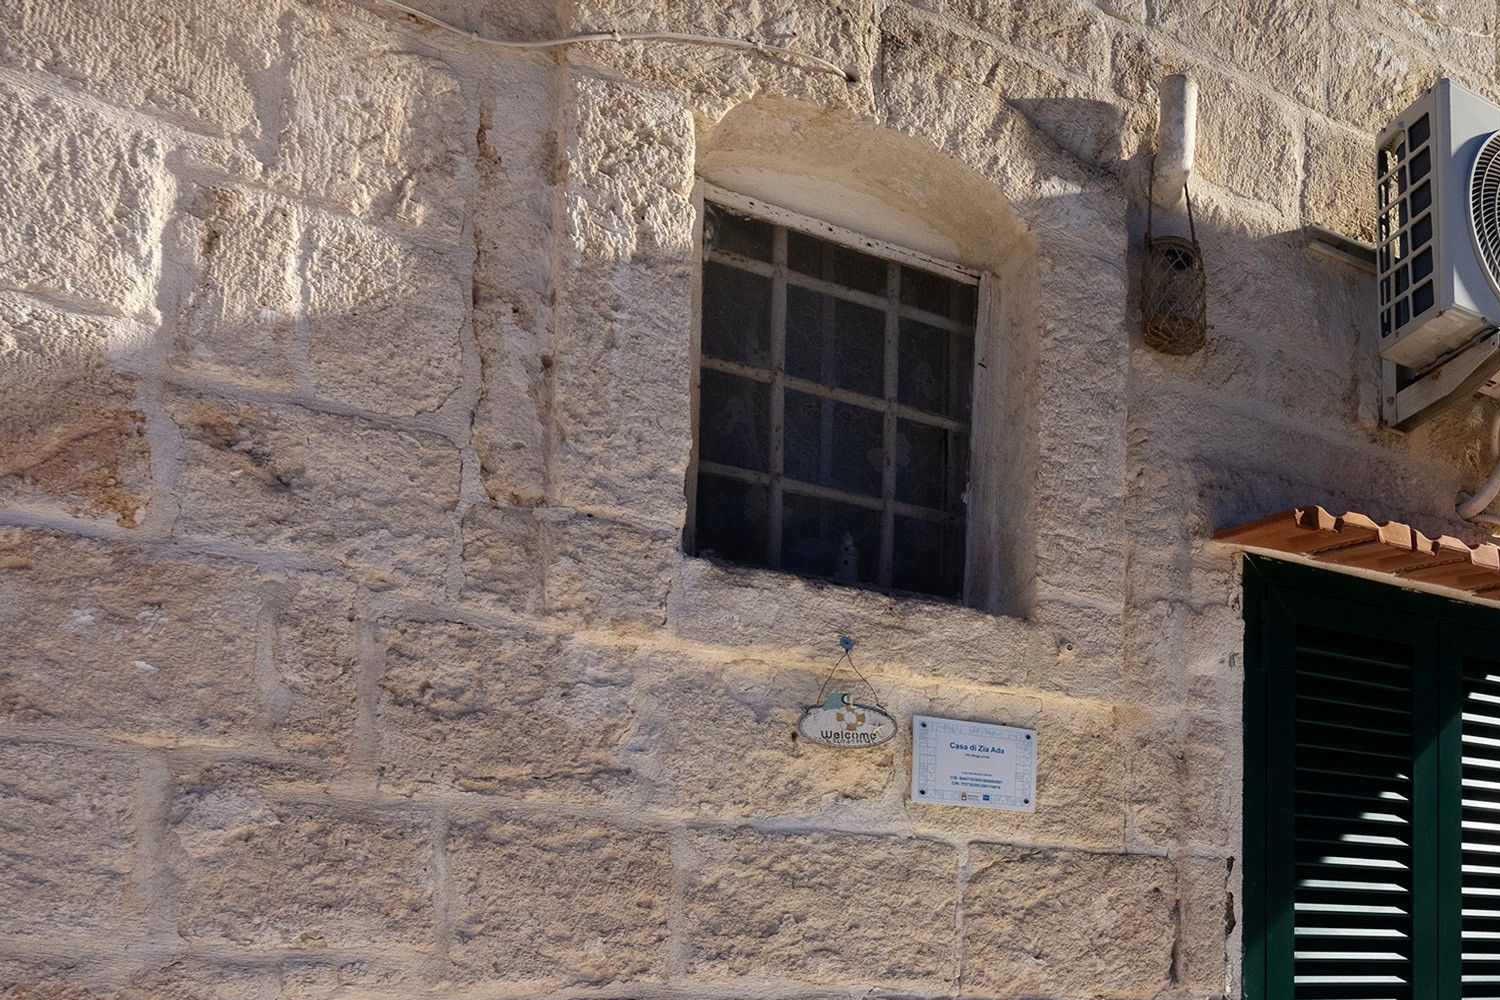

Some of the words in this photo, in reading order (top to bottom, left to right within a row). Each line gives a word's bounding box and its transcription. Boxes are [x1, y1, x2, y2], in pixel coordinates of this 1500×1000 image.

[820, 730, 877, 741] Welcome
[950, 741, 968, 750] Casa
[990, 746, 1005, 754] Ada
